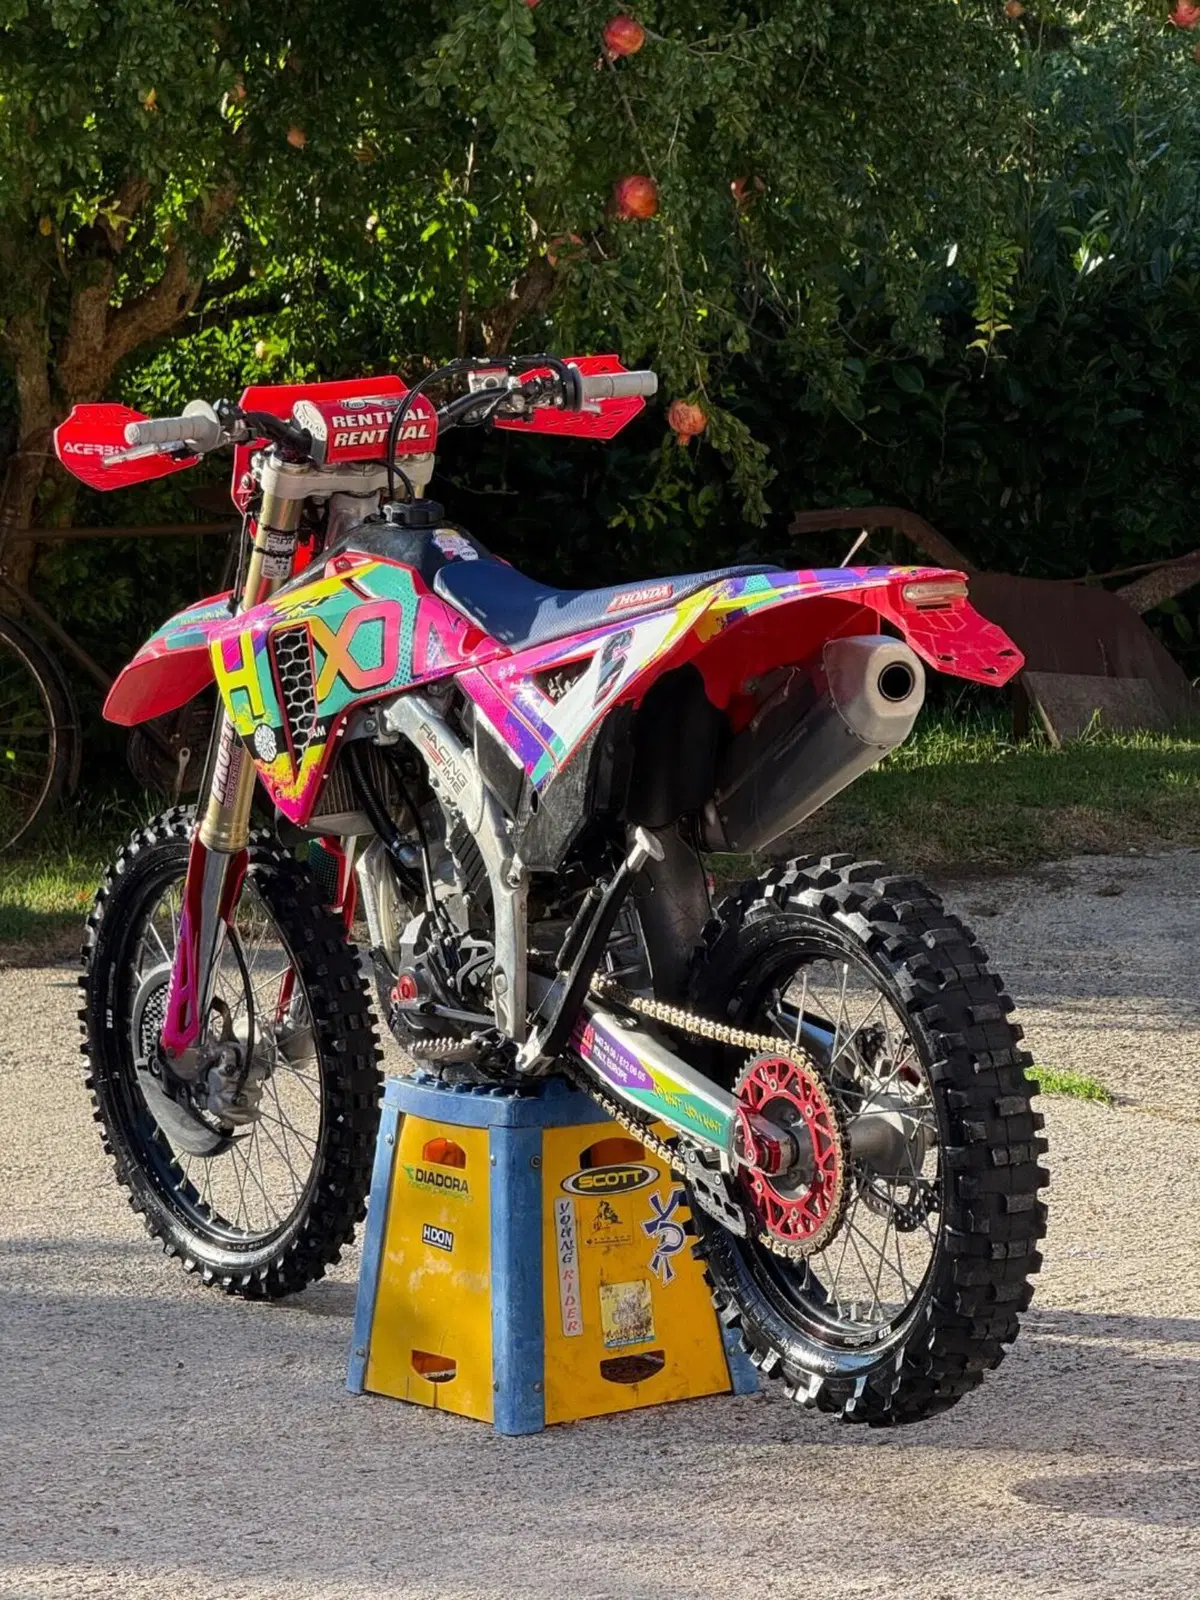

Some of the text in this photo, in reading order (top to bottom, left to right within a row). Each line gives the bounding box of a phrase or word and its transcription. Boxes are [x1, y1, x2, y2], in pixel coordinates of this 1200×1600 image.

[620, 585, 668, 604] HONDA
[419, 722, 469, 788] RACING
[415, 1168, 469, 1193] DIADORA
[578, 1169, 643, 1189] SCOTT
[560, 1201, 579, 1333] YOUNG RIDER
